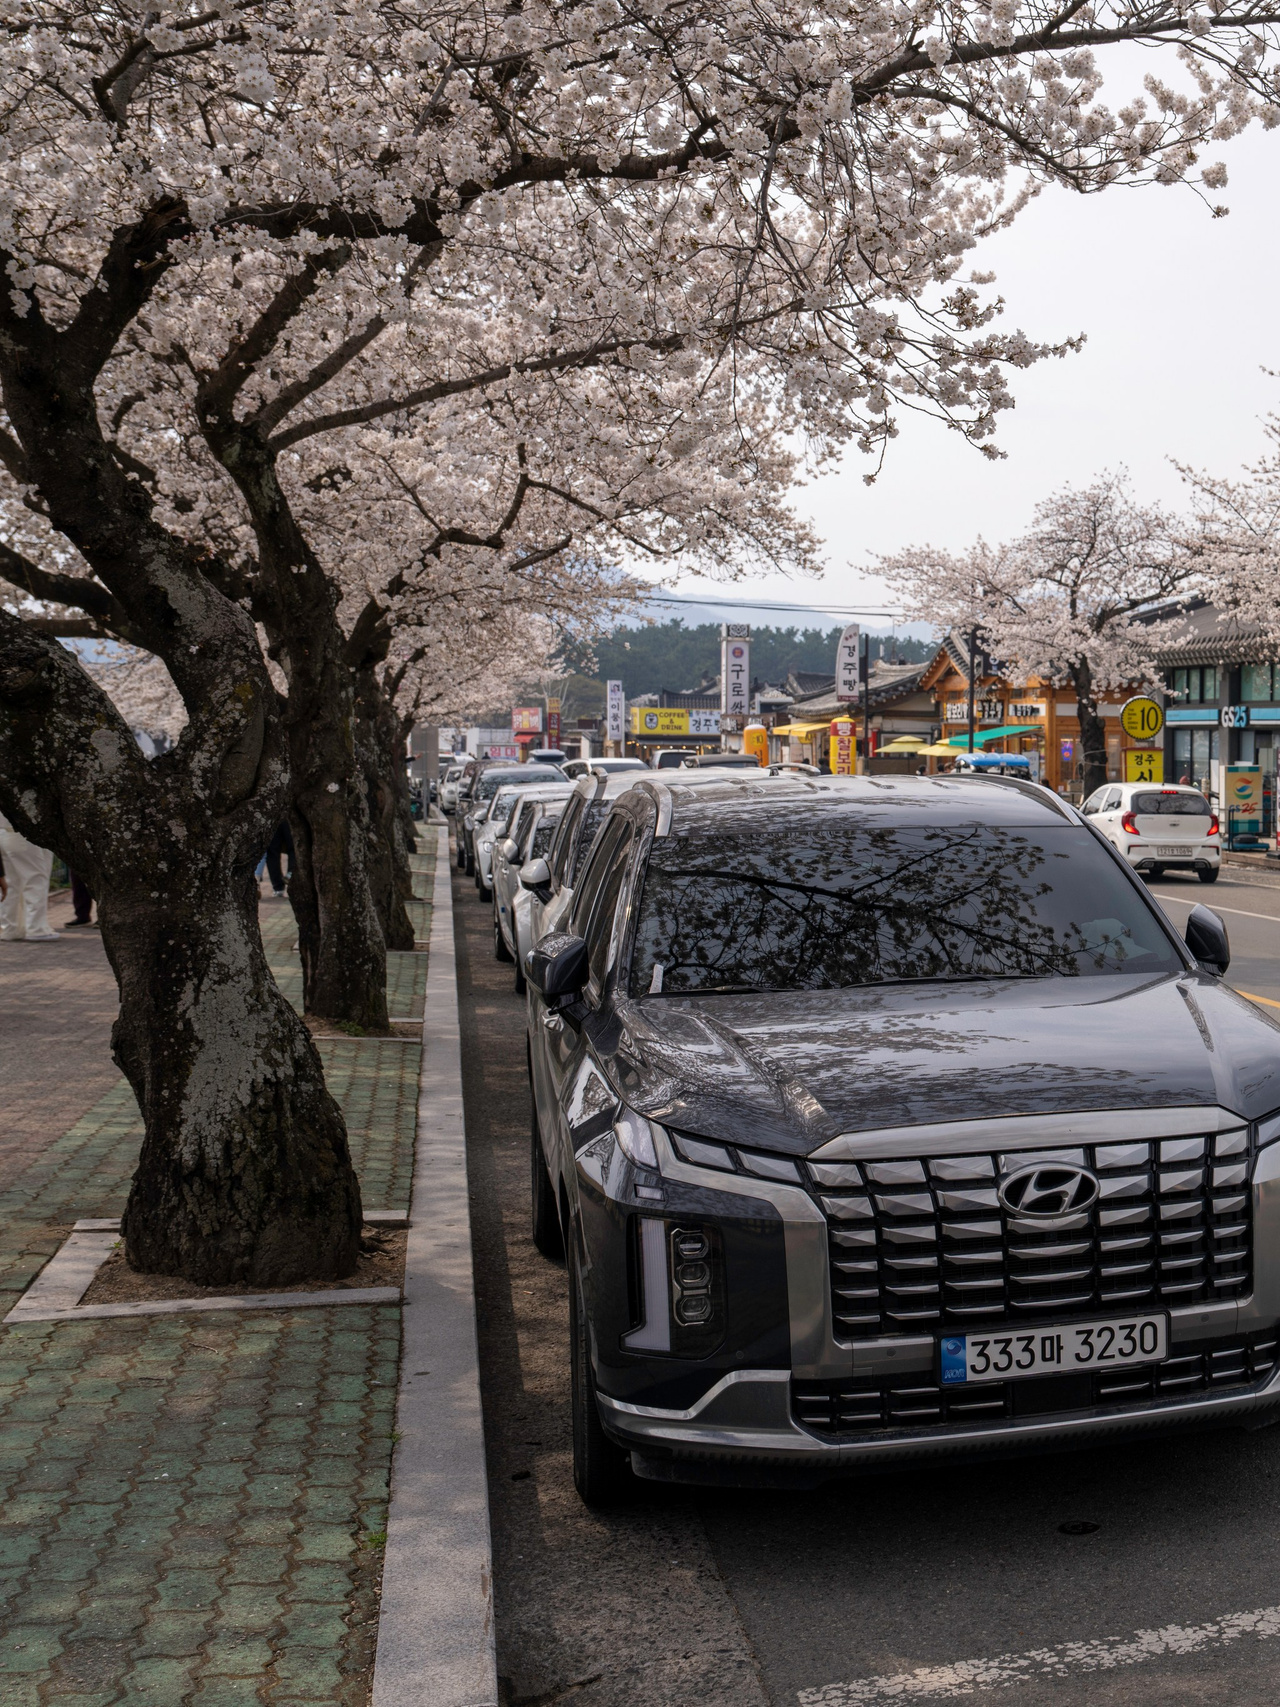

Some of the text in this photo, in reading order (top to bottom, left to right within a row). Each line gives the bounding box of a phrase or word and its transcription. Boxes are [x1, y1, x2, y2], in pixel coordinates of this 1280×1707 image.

[843, 644, 857, 691] 경주빵
[1140, 707, 1158, 731] 10
[1221, 706, 1247, 728] GS25
[1134, 754, 1156, 766] 경주
[1229, 802, 1258, 814] GS 25
[970, 1321, 1158, 1374] 333마 3230
[944, 1369, 965, 1379] KOR
